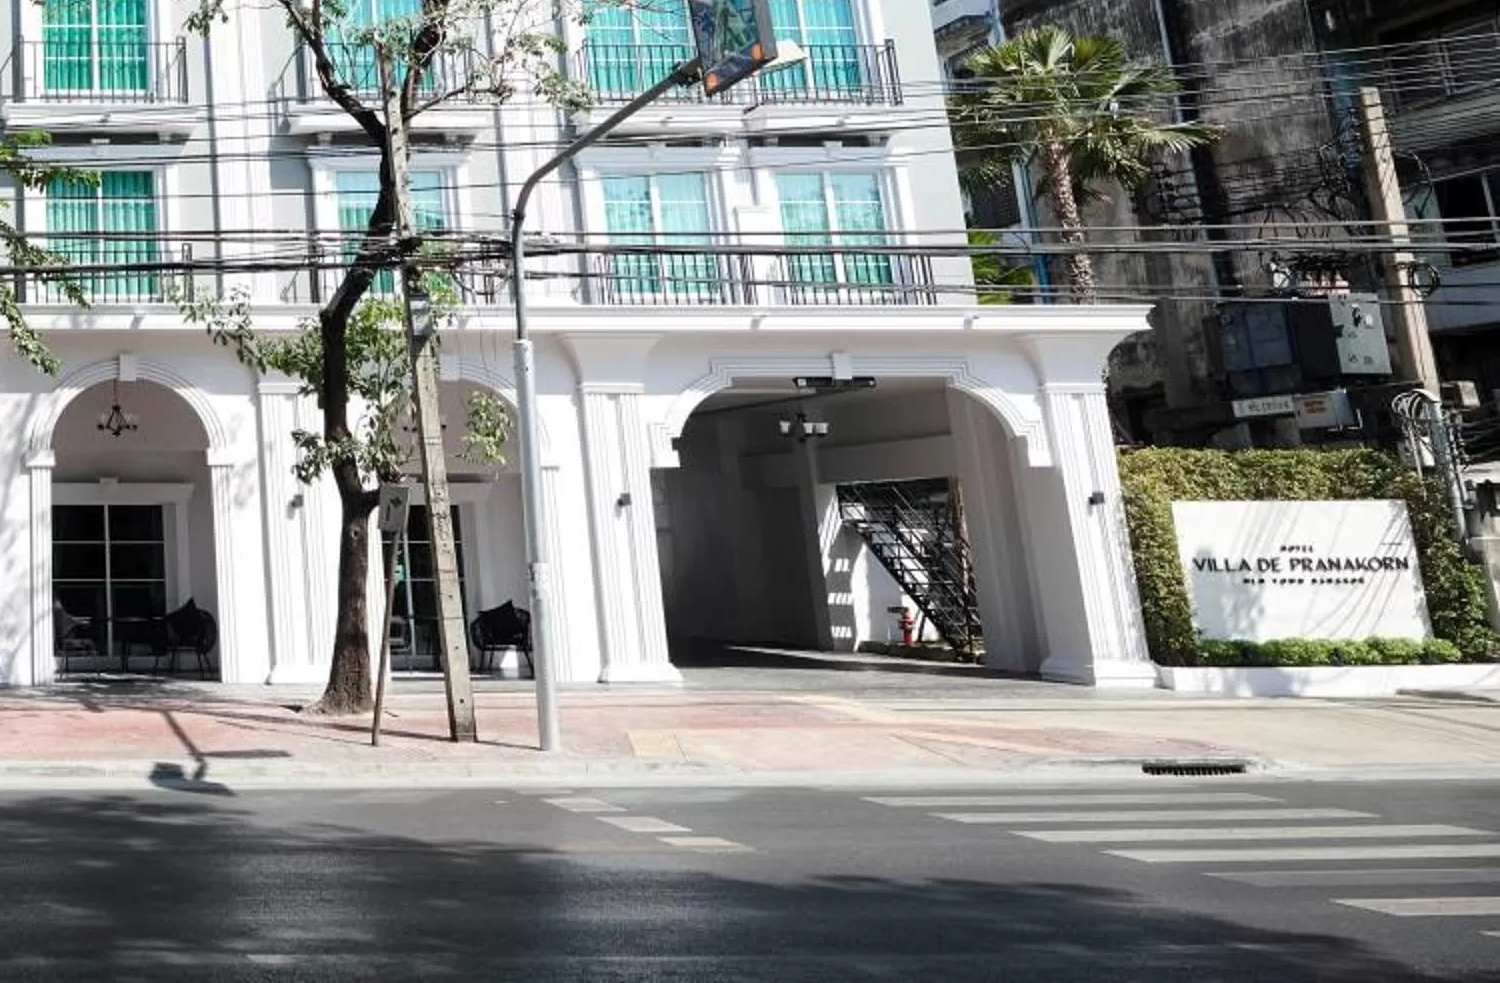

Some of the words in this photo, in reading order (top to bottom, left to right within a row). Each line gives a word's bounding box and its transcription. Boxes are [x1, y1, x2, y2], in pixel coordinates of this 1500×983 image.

[1192, 557, 1252, 572] VILLA
[1257, 557, 1281, 572] DE
[1289, 556, 1409, 572] PRANAKORN
